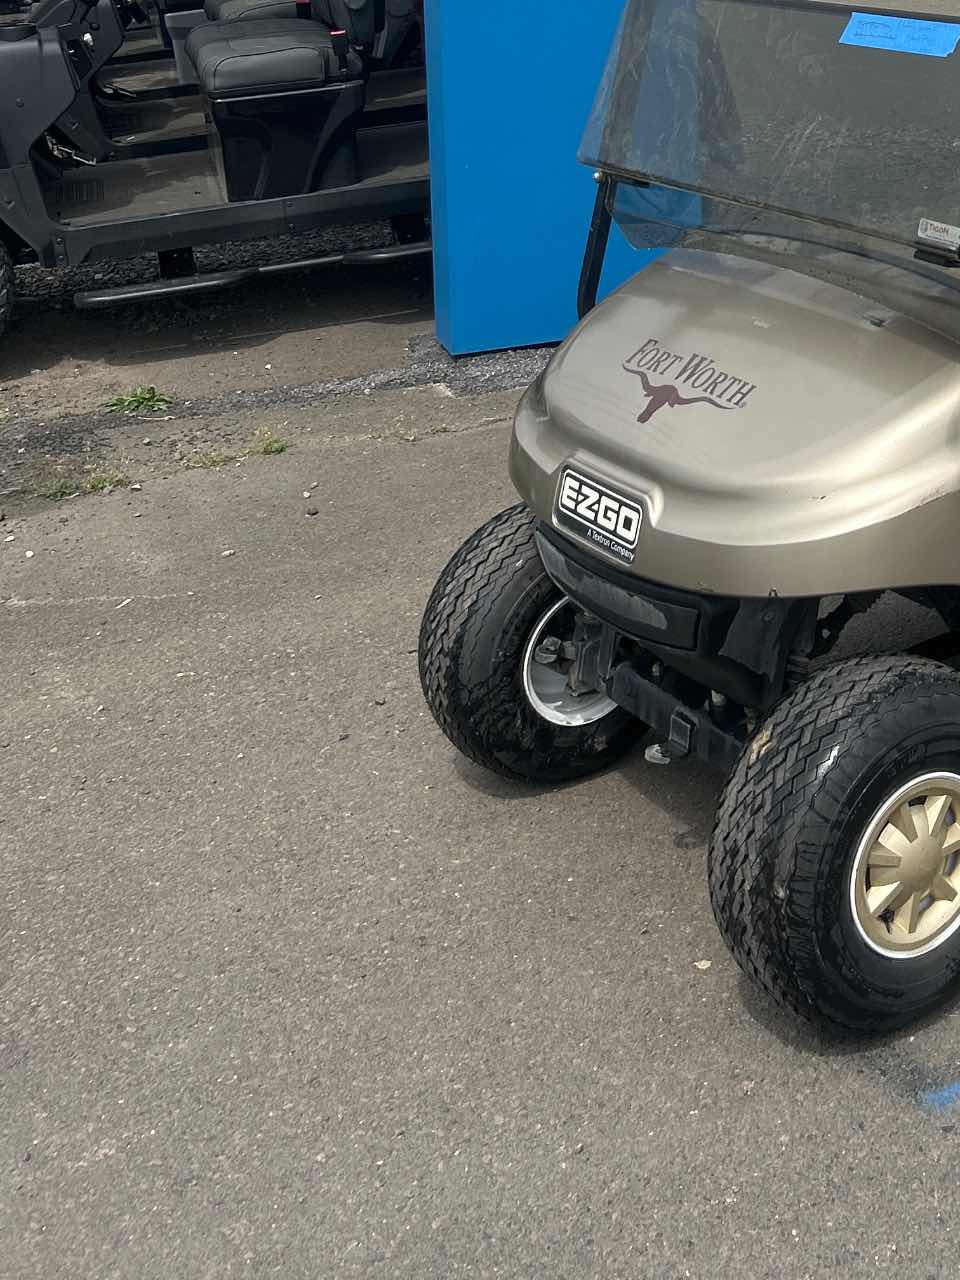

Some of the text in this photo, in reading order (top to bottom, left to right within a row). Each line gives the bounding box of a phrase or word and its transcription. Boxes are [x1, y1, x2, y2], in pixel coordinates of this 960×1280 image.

[625, 338, 757, 406] FORT WORTH
[592, 530, 610, 547] Textron
[610, 541, 634, 561] Company
